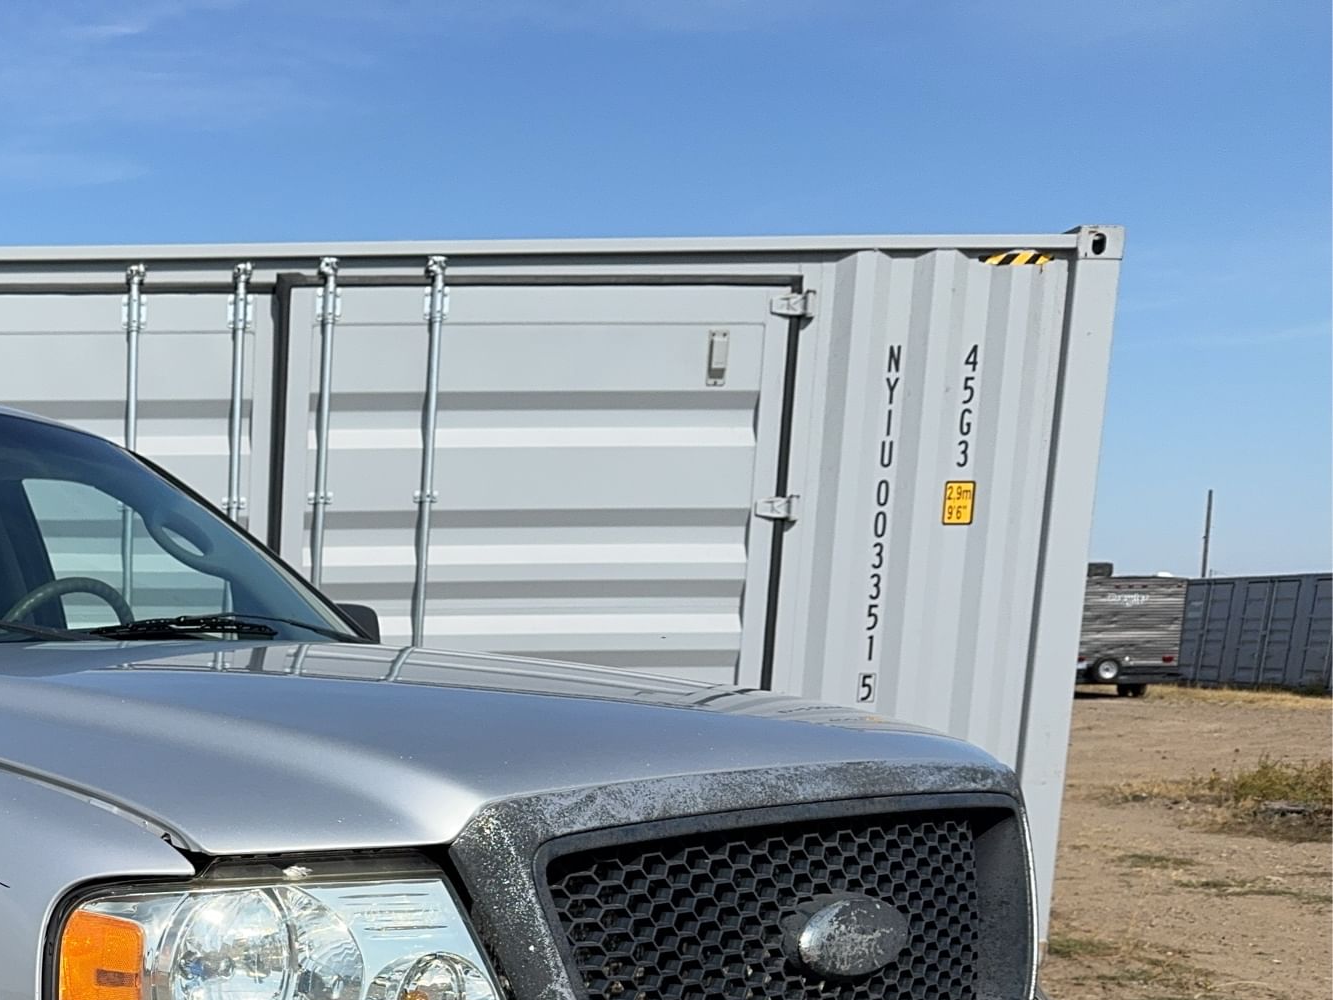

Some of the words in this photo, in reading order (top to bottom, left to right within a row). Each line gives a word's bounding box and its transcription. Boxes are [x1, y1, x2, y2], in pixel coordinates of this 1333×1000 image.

[879, 345, 902, 468] NYIU
[956, 344, 979, 468] 45G3
[865, 479, 891, 662] 003351
[859, 673, 874, 702] 5
